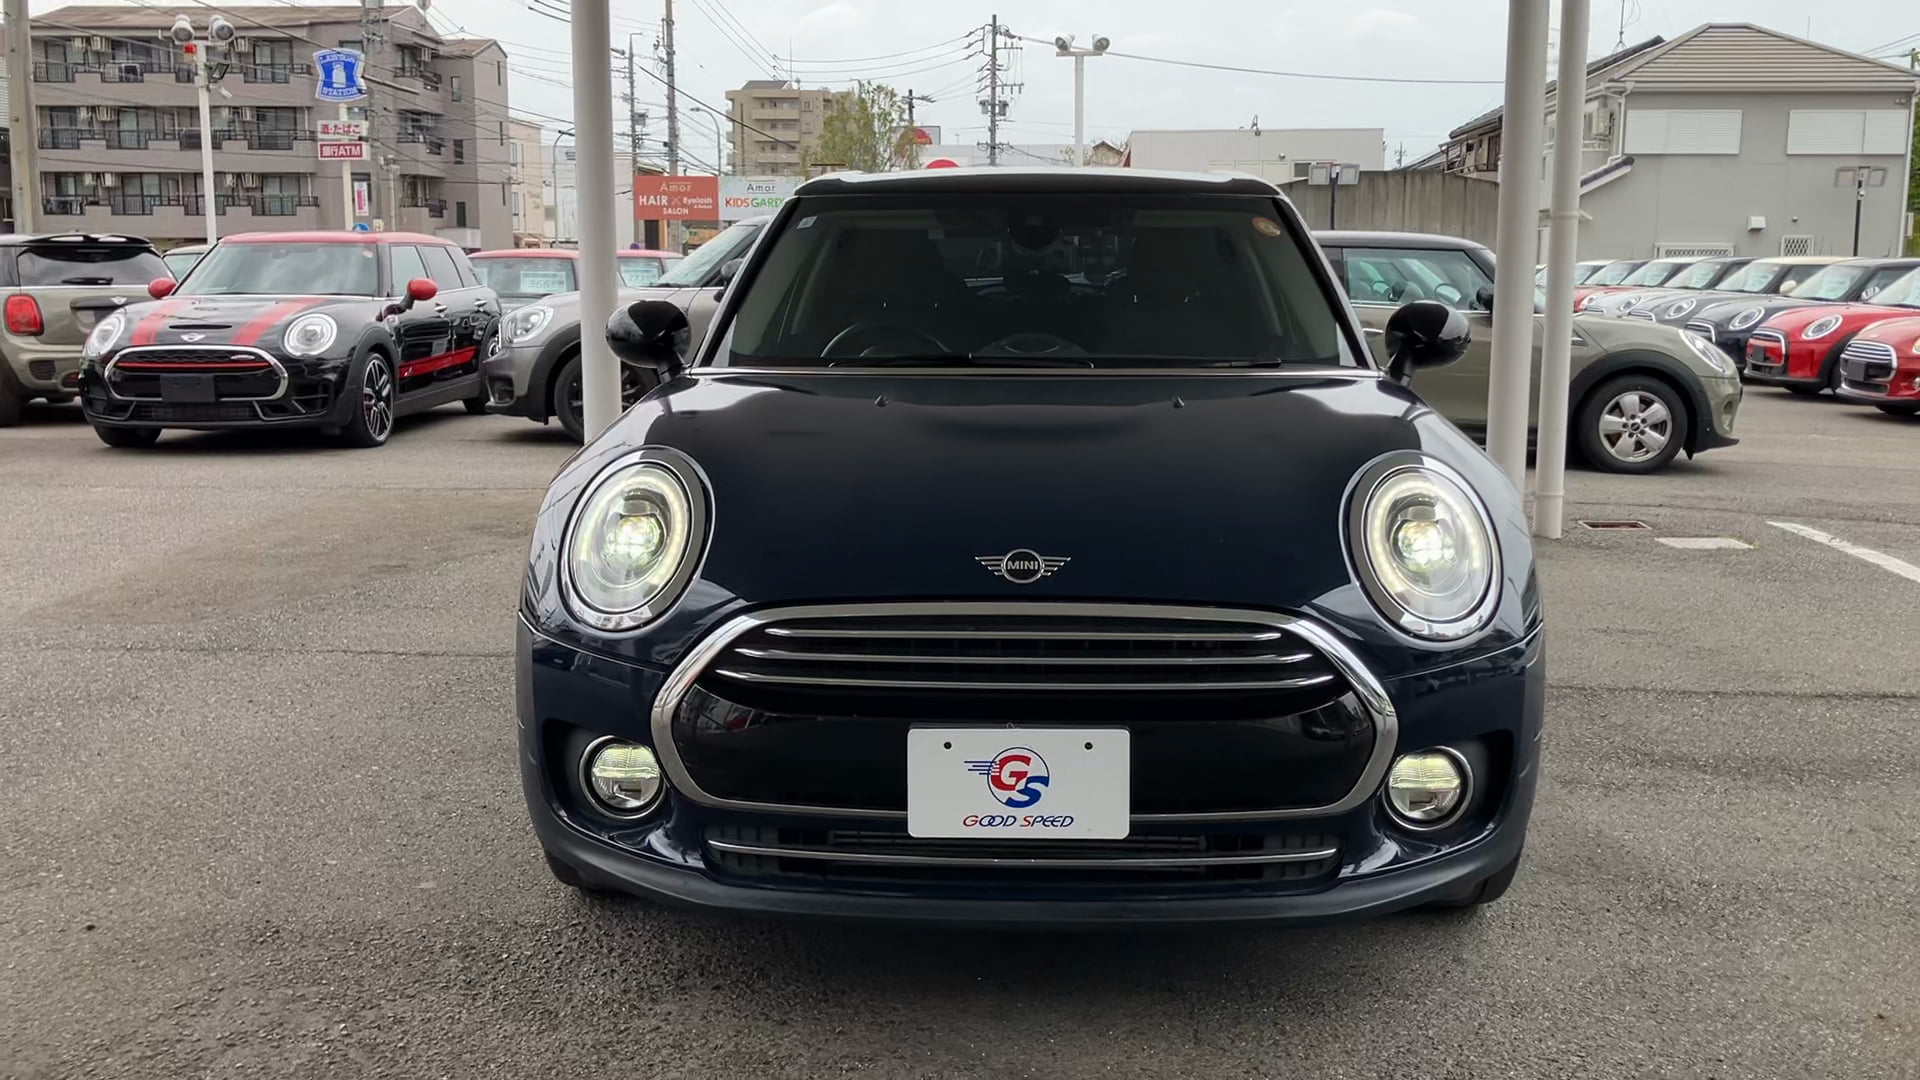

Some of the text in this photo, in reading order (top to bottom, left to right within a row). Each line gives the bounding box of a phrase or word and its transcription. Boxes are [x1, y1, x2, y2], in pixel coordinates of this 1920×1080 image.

[323, 86, 358, 96] STATION
[322, 145, 361, 156] 銀行ATM
[659, 182, 691, 192] Amor
[747, 183, 776, 192] Amor
[639, 195, 669, 206] HAIR
[725, 197, 750, 208] KIDS
[751, 197, 785, 208] GARD
[662, 207, 689, 215] SALON
[1007, 560, 1039, 570] MINI
[963, 815, 1075, 828] GOOD SPEED
